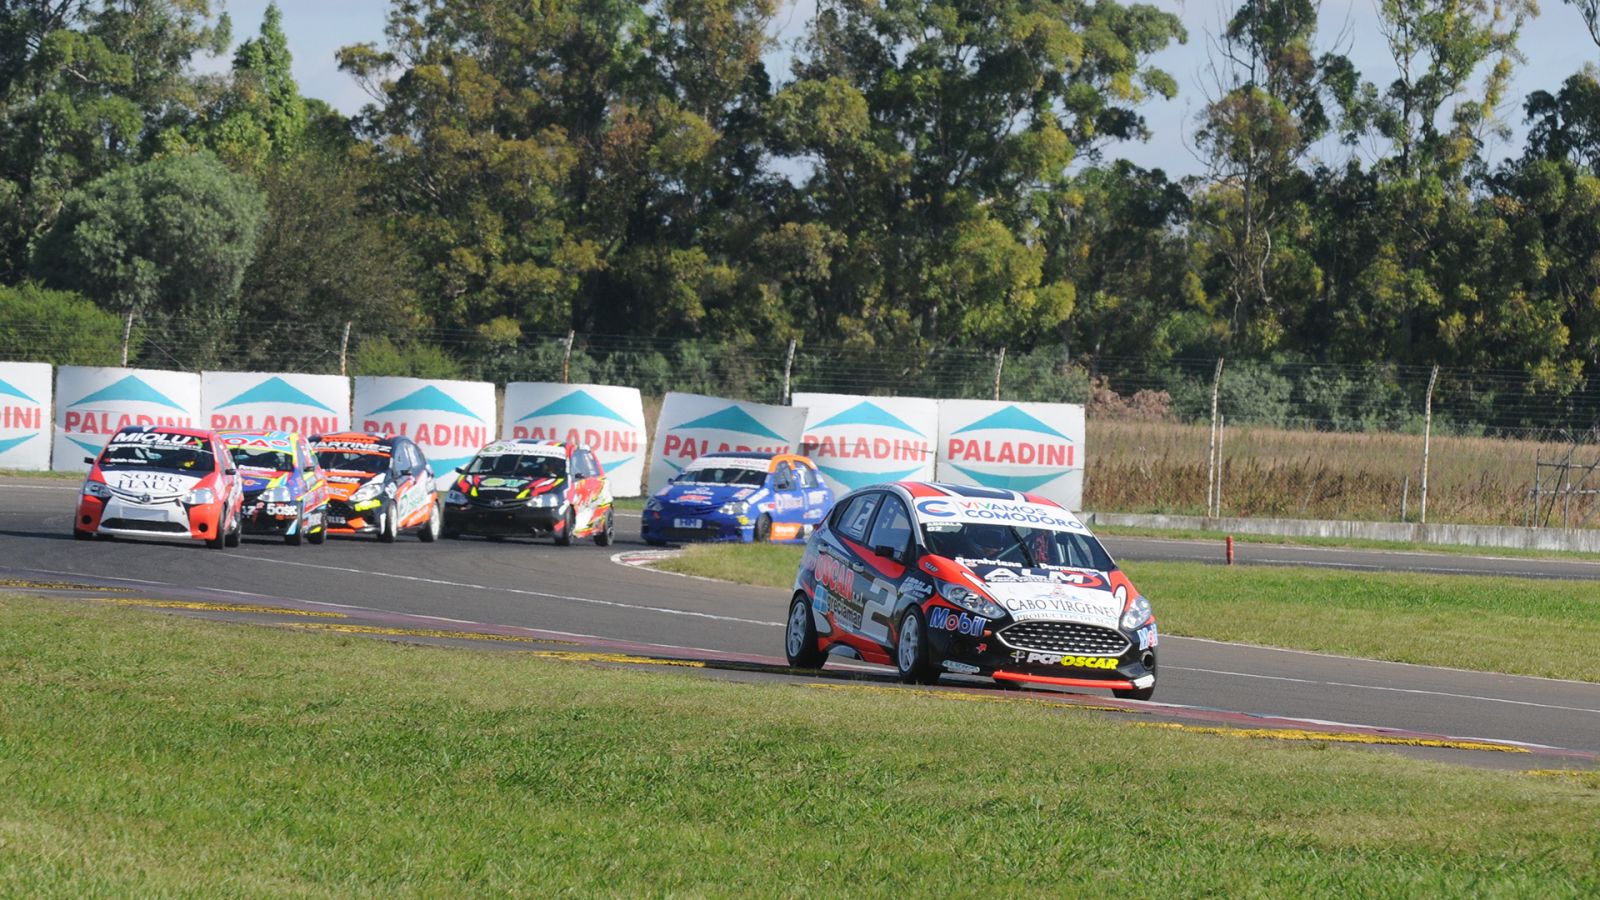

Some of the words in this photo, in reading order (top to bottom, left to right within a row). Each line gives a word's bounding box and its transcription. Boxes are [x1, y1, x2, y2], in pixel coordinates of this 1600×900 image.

[0, 405, 41, 429] INI
[803, 434, 928, 462] PALADINI
[948, 438, 1074, 467] PALADINI
[959, 501, 1047, 517] VIVAMOS
[964, 508, 1084, 530] COMODORO
[860, 577, 898, 643] 2
[1005, 598, 1047, 612] CABO
[929, 606, 987, 637] Mobil
